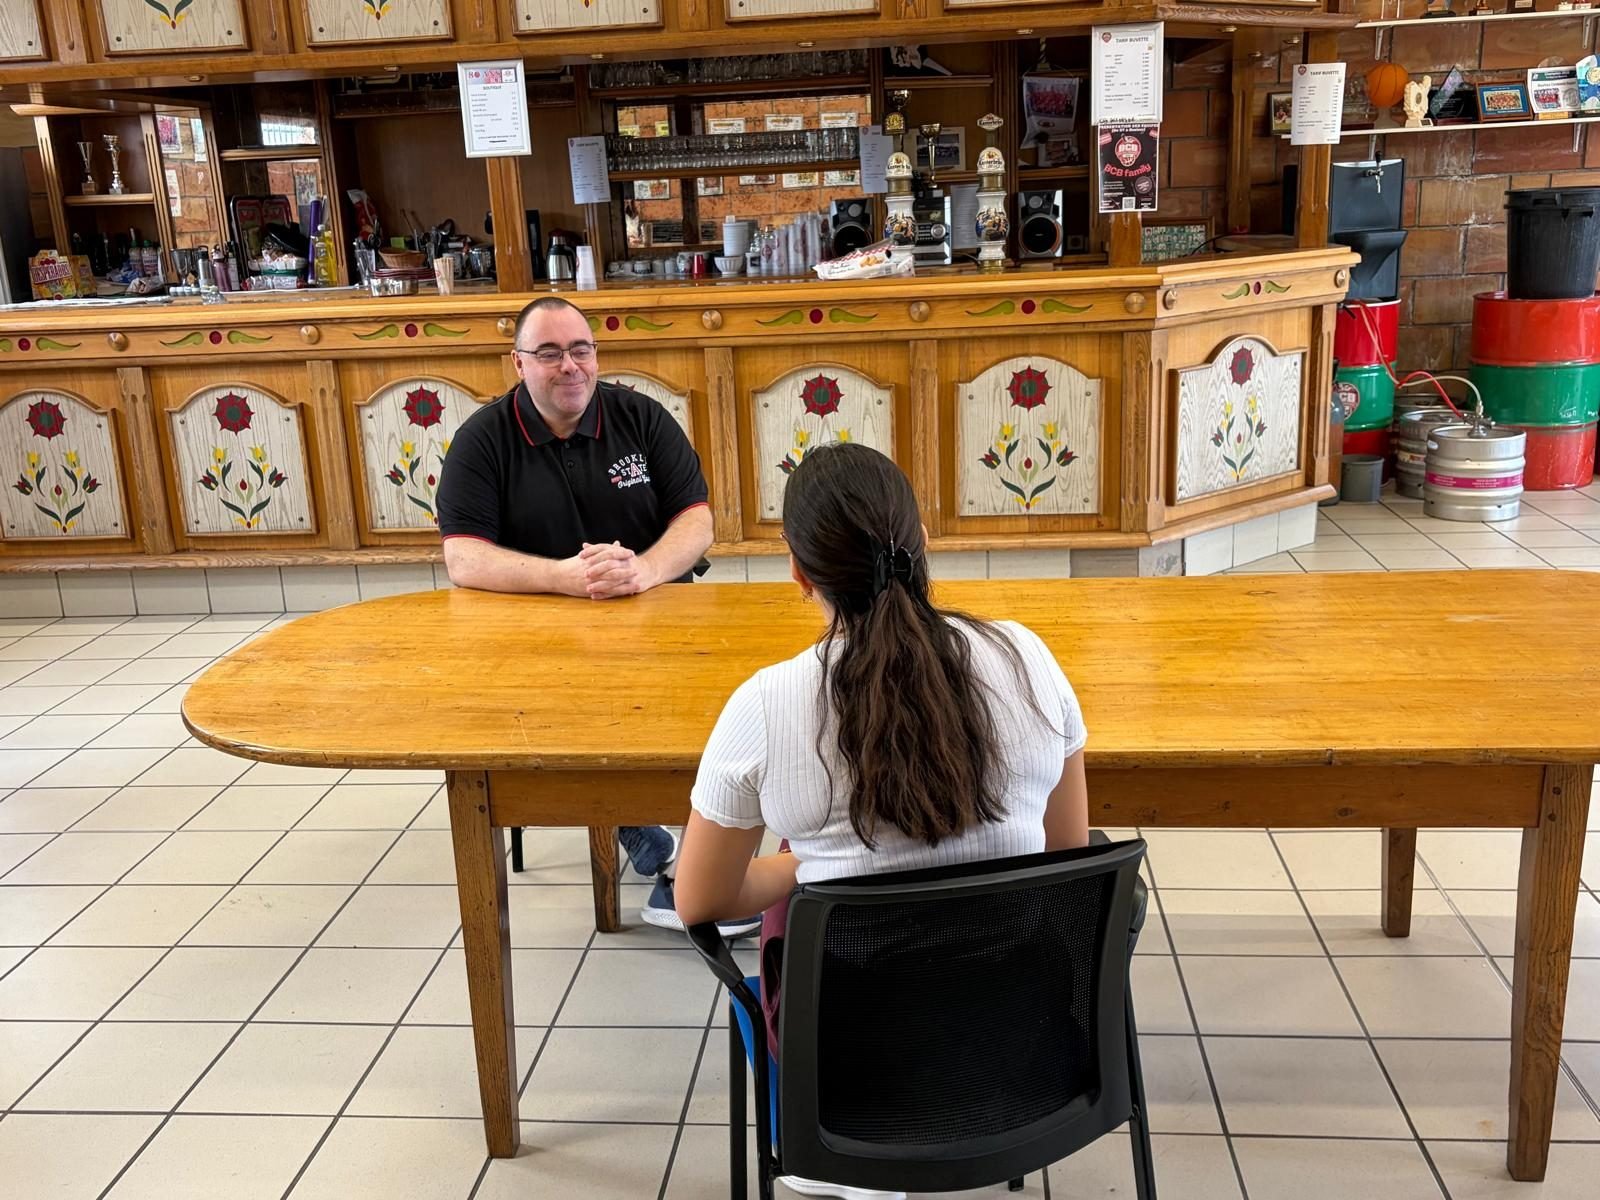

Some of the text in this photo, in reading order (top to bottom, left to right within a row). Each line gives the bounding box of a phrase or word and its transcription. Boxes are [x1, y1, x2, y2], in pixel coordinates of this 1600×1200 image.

[1104, 163, 1152, 177] BCB family
[620, 462, 648, 477] STATE
